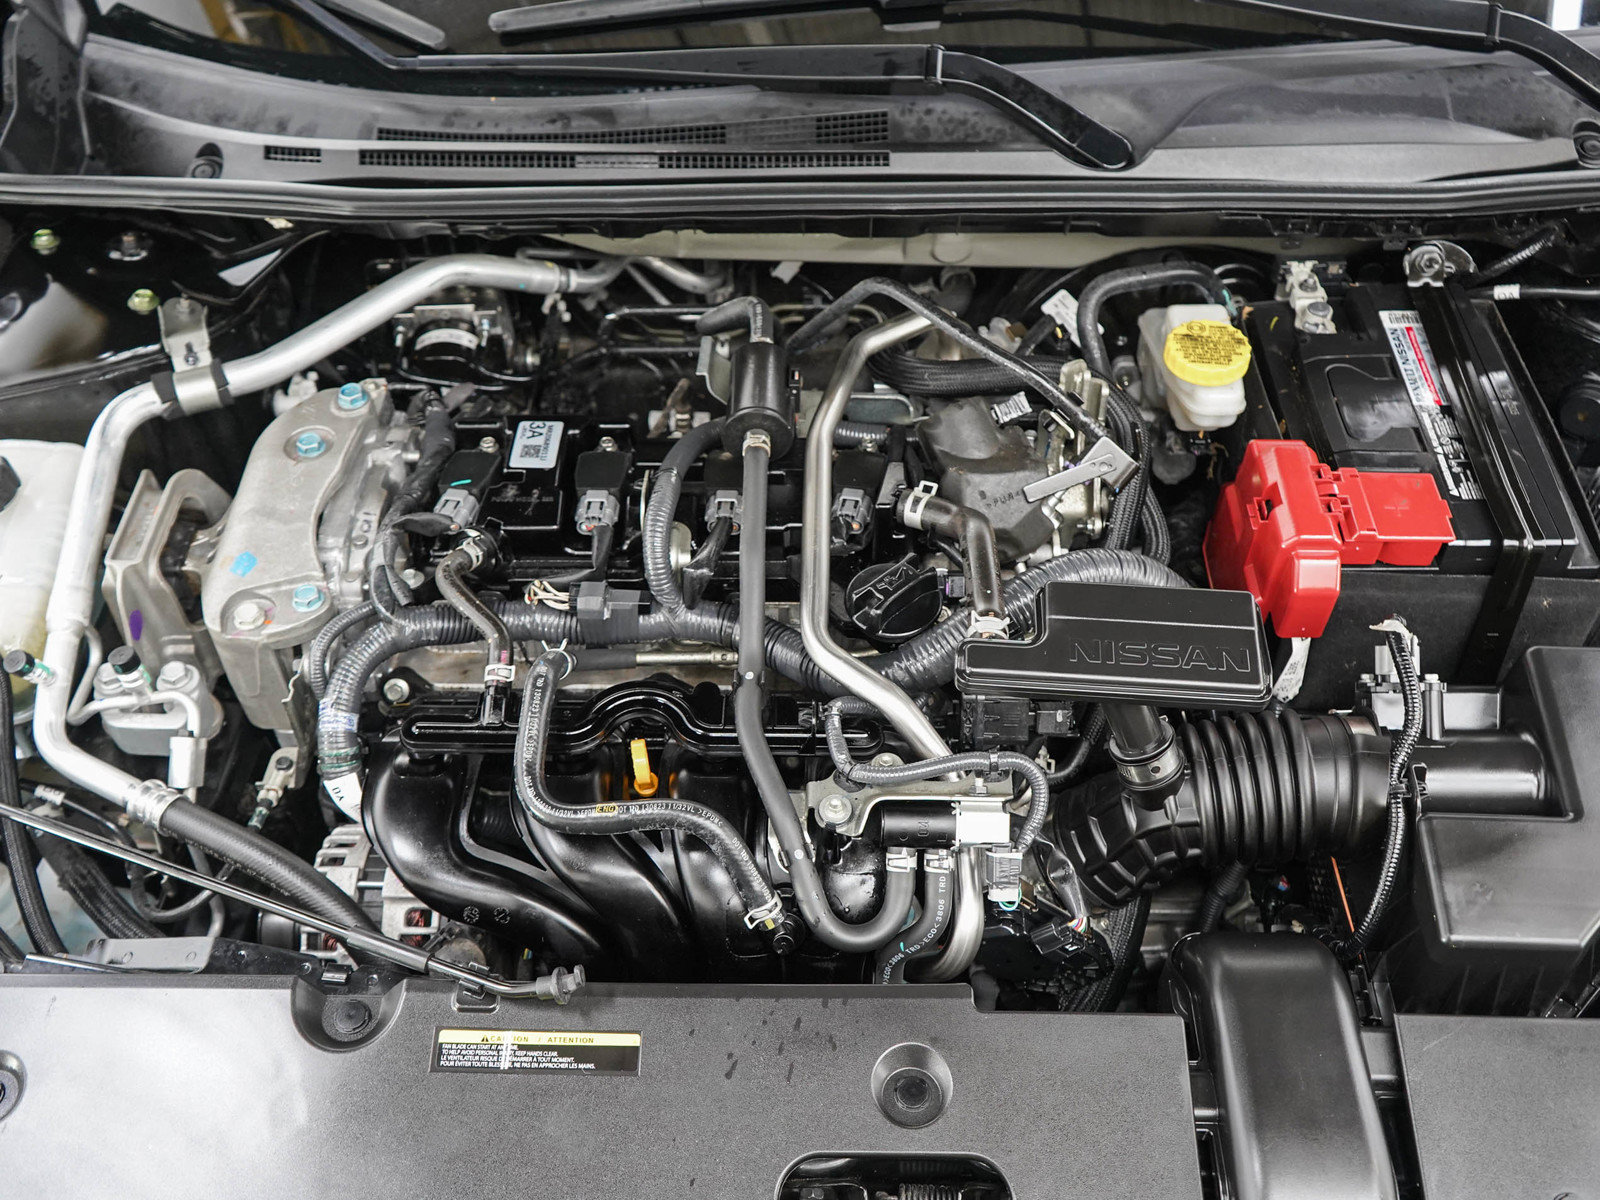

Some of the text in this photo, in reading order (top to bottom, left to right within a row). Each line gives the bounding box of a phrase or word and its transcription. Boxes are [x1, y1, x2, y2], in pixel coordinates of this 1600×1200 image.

[1388, 328, 1412, 366] NISSAN
[526, 422, 546, 439] 3A
[1069, 638, 1252, 672] NISSAN
[642, 803, 666, 813] 130823
